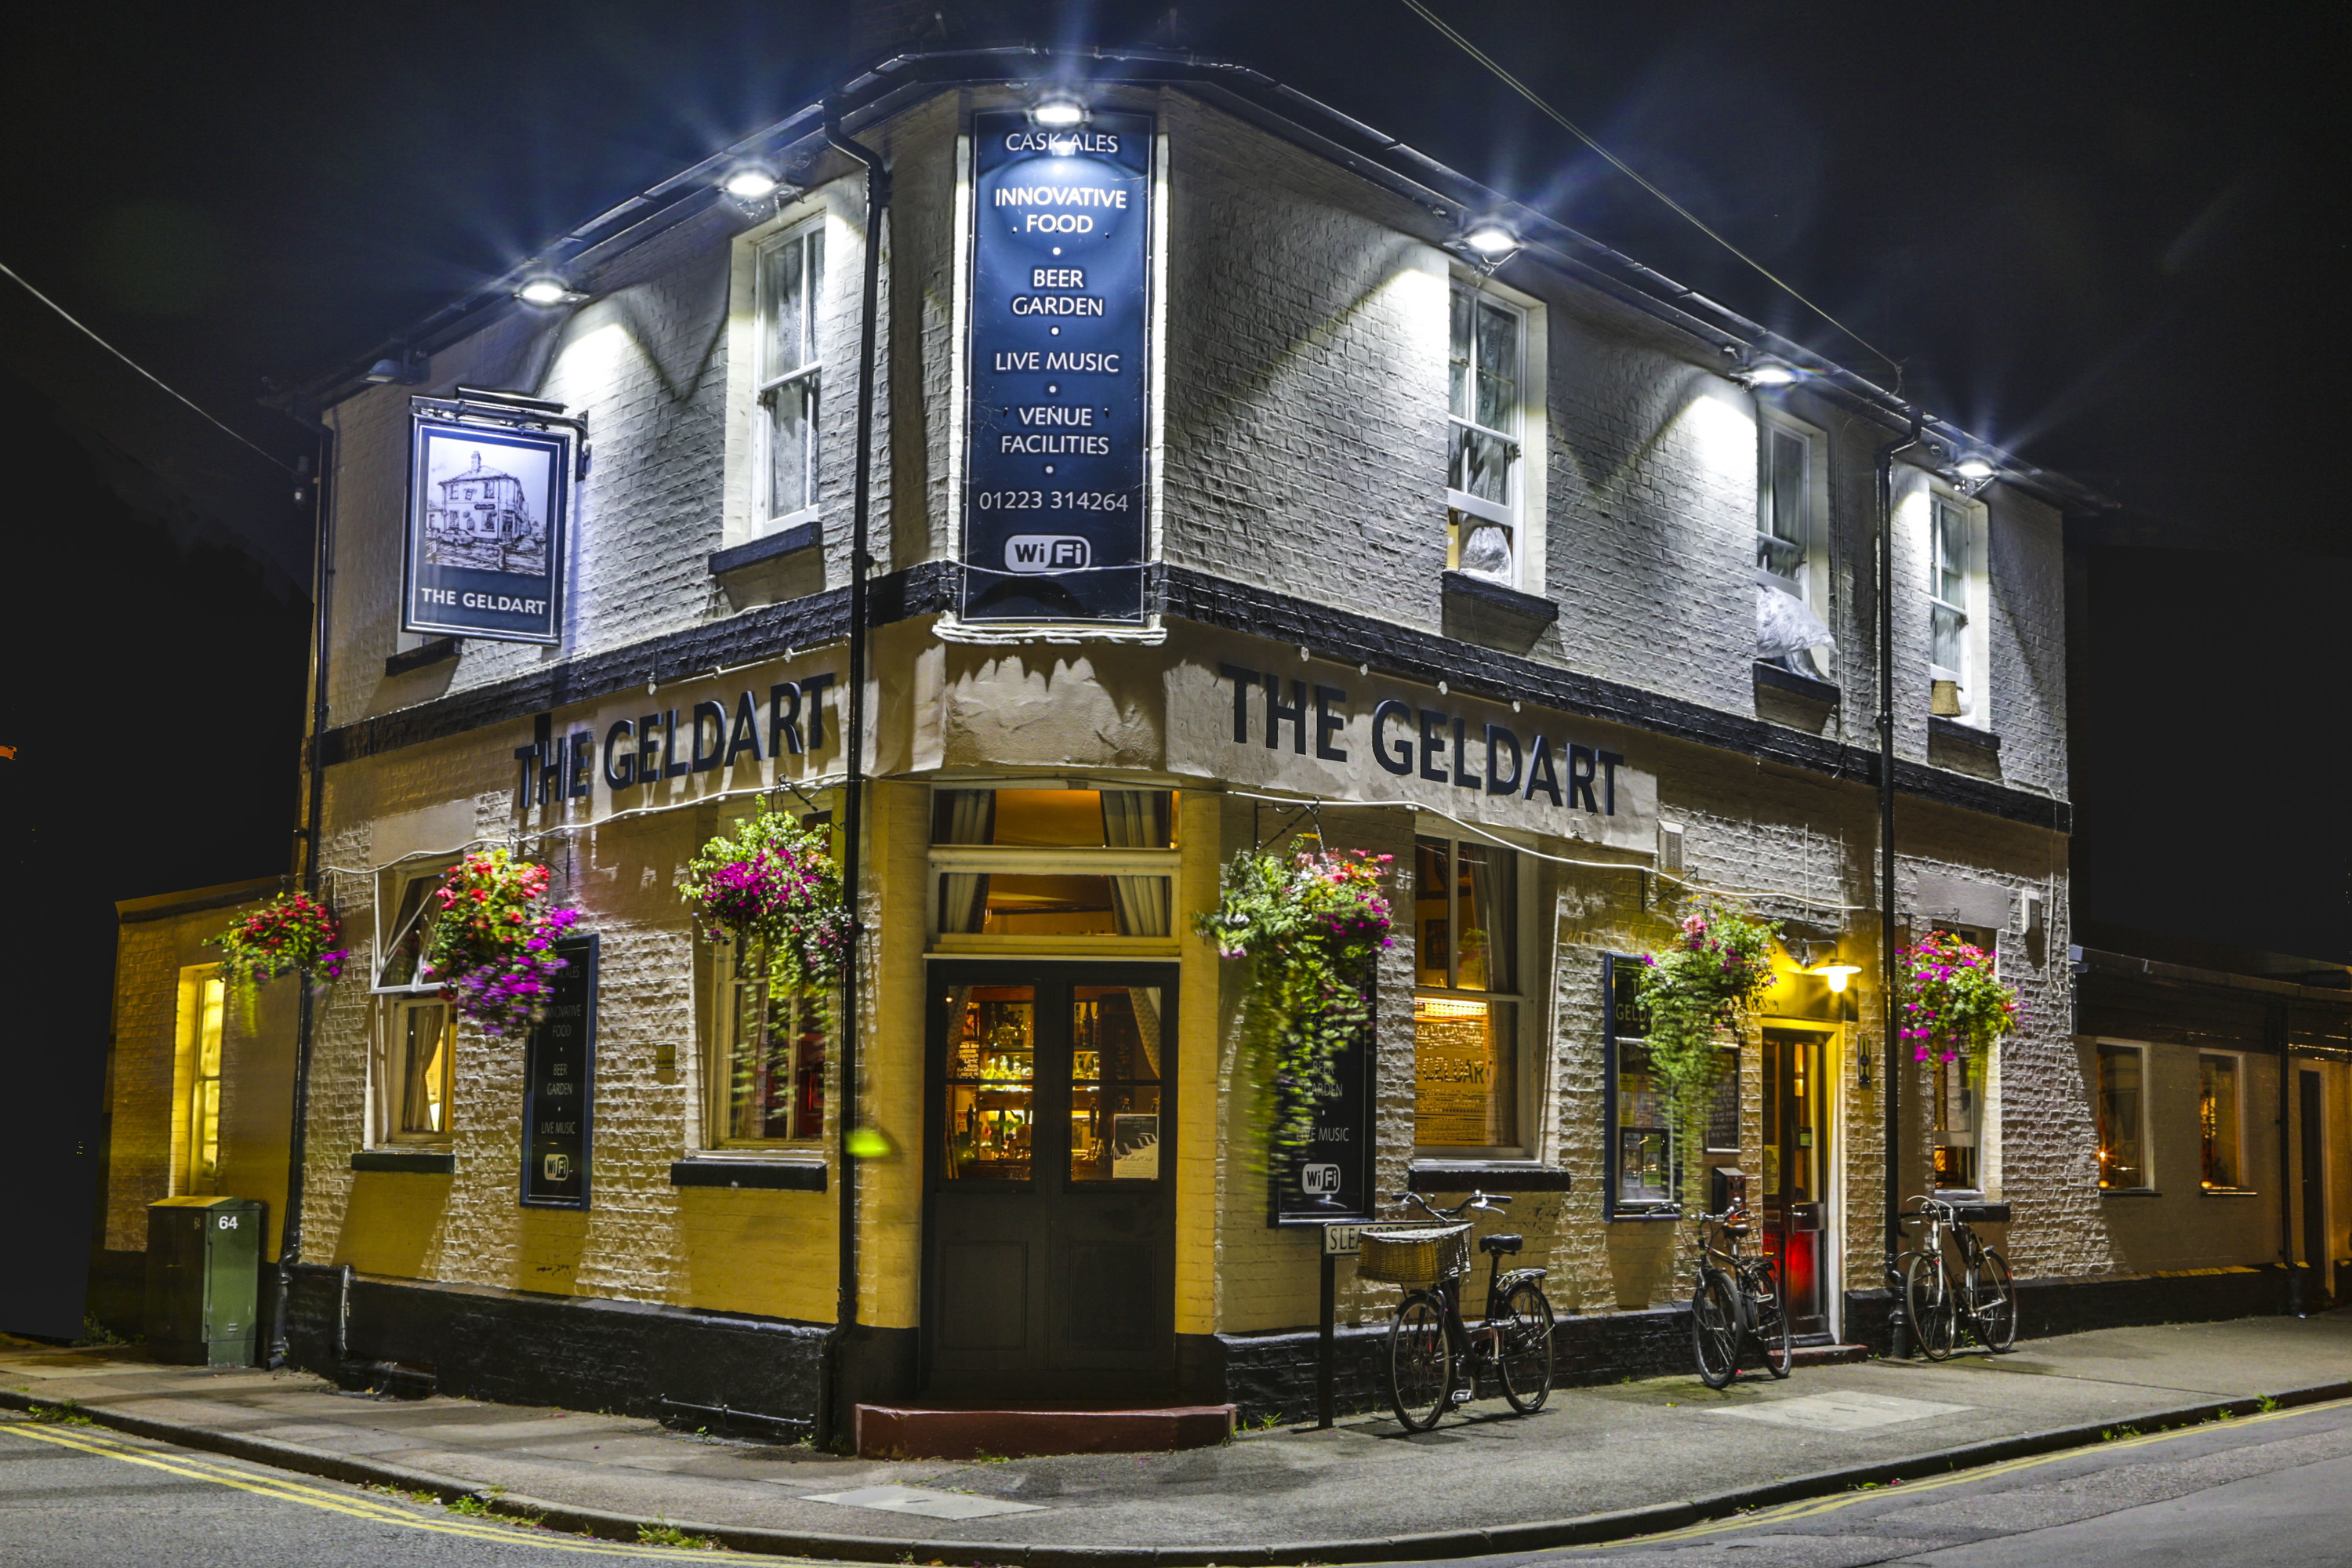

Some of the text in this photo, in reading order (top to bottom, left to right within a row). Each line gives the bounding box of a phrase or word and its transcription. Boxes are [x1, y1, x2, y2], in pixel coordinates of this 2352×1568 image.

[1006, 132, 1119, 153] CASK ALES
[995, 187, 1127, 209] INNOVATIVE
[1026, 214, 1094, 233] FOOD
[1033, 269, 1084, 288] BEER
[1012, 296, 1103, 317] GARDEN
[996, 352, 1120, 372] LIVE MUSIC
[1019, 407, 1092, 426] VENUE
[1001, 434, 1109, 455] FACILITIES
[979, 491, 1129, 512] 01223 314264
[421, 587, 546, 615] THE GELDART
[514, 672, 835, 808] THE GELDART
[1221, 663, 1625, 816] THE GELDART
[546, 1004, 582, 1018] NNOVATIVE
[552, 1024, 572, 1038] FOOD
[553, 1063, 568, 1076] BEER
[1312, 1061, 1334, 1075] BEER
[546, 1082, 573, 1096] GARDEN
[541, 1121, 576, 1134] LIVE MUSIC
[1318, 1127, 1349, 1142] MUSIC
[219, 1216, 238, 1229] 64
